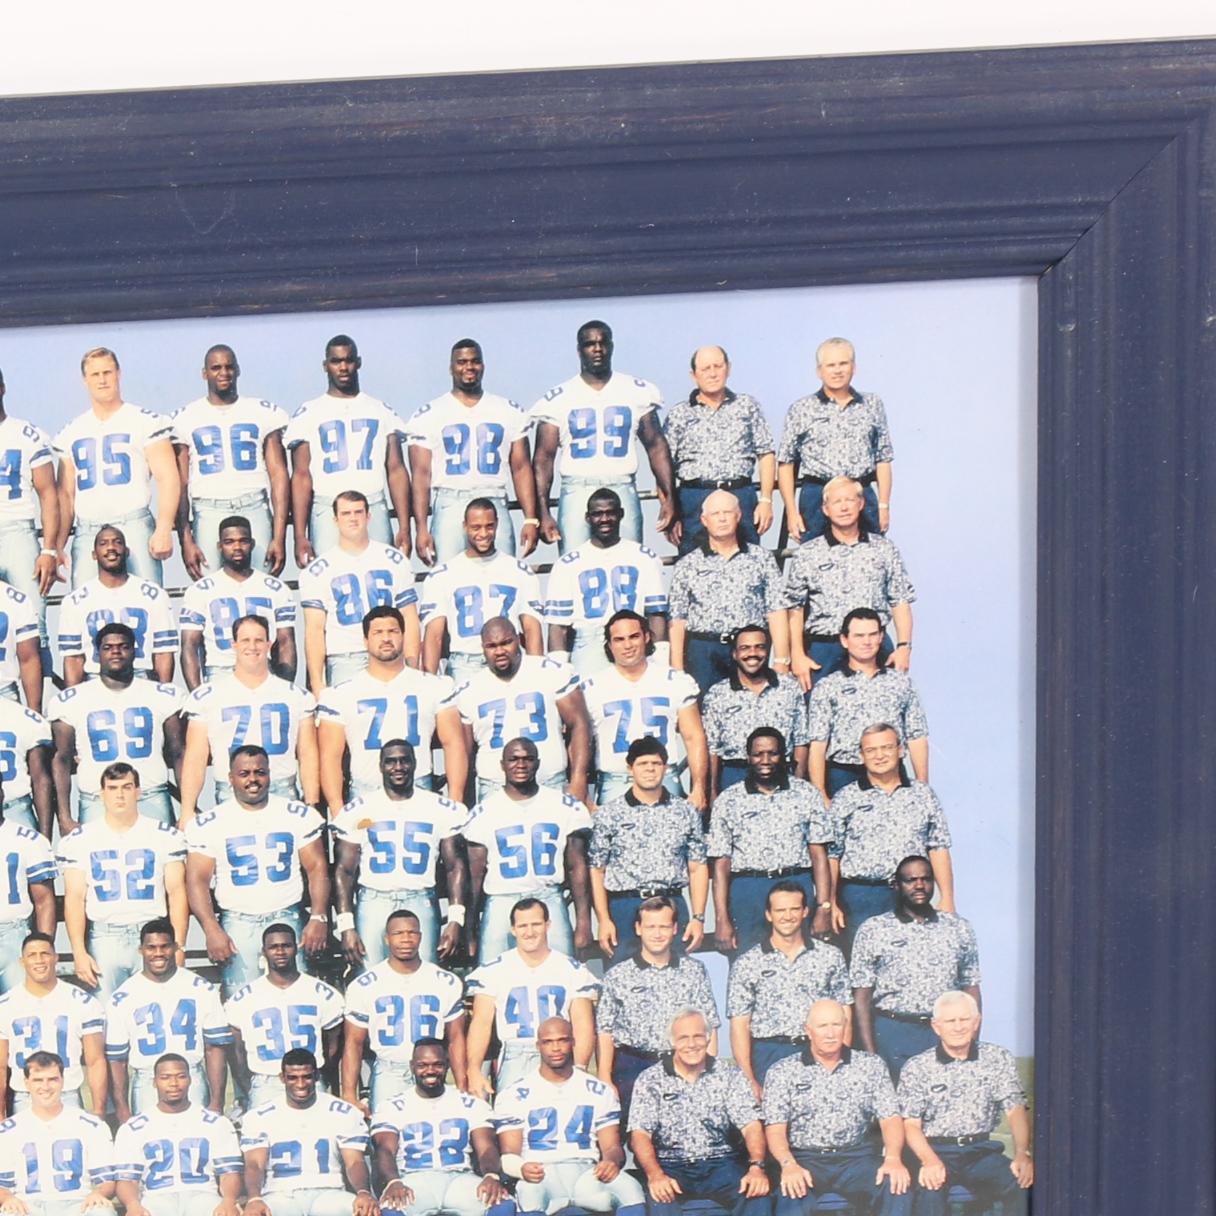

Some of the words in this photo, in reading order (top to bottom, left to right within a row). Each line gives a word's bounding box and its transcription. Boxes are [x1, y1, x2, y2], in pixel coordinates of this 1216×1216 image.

[192, 423, 260, 476] 96
[319, 418, 380, 474] 97
[443, 422, 505, 476] 98
[569, 405, 633, 460] 99
[71, 436, 132, 491] 95
[87, 706, 154, 763] 69
[229, 703, 291, 757] 70
[359, 694, 422, 751] 71
[478, 691, 549, 750] 73
[88, 848, 155, 901] 52
[226, 831, 295, 887] 53
[367, 820, 434, 876] 55
[495, 822, 561, 880] 56
[138, 998, 197, 1057] 34
[253, 1004, 318, 1062] 35
[527, 1104, 595, 1152] 24
[26, 1140, 84, 1194] 19
[143, 1138, 210, 1190] 20
